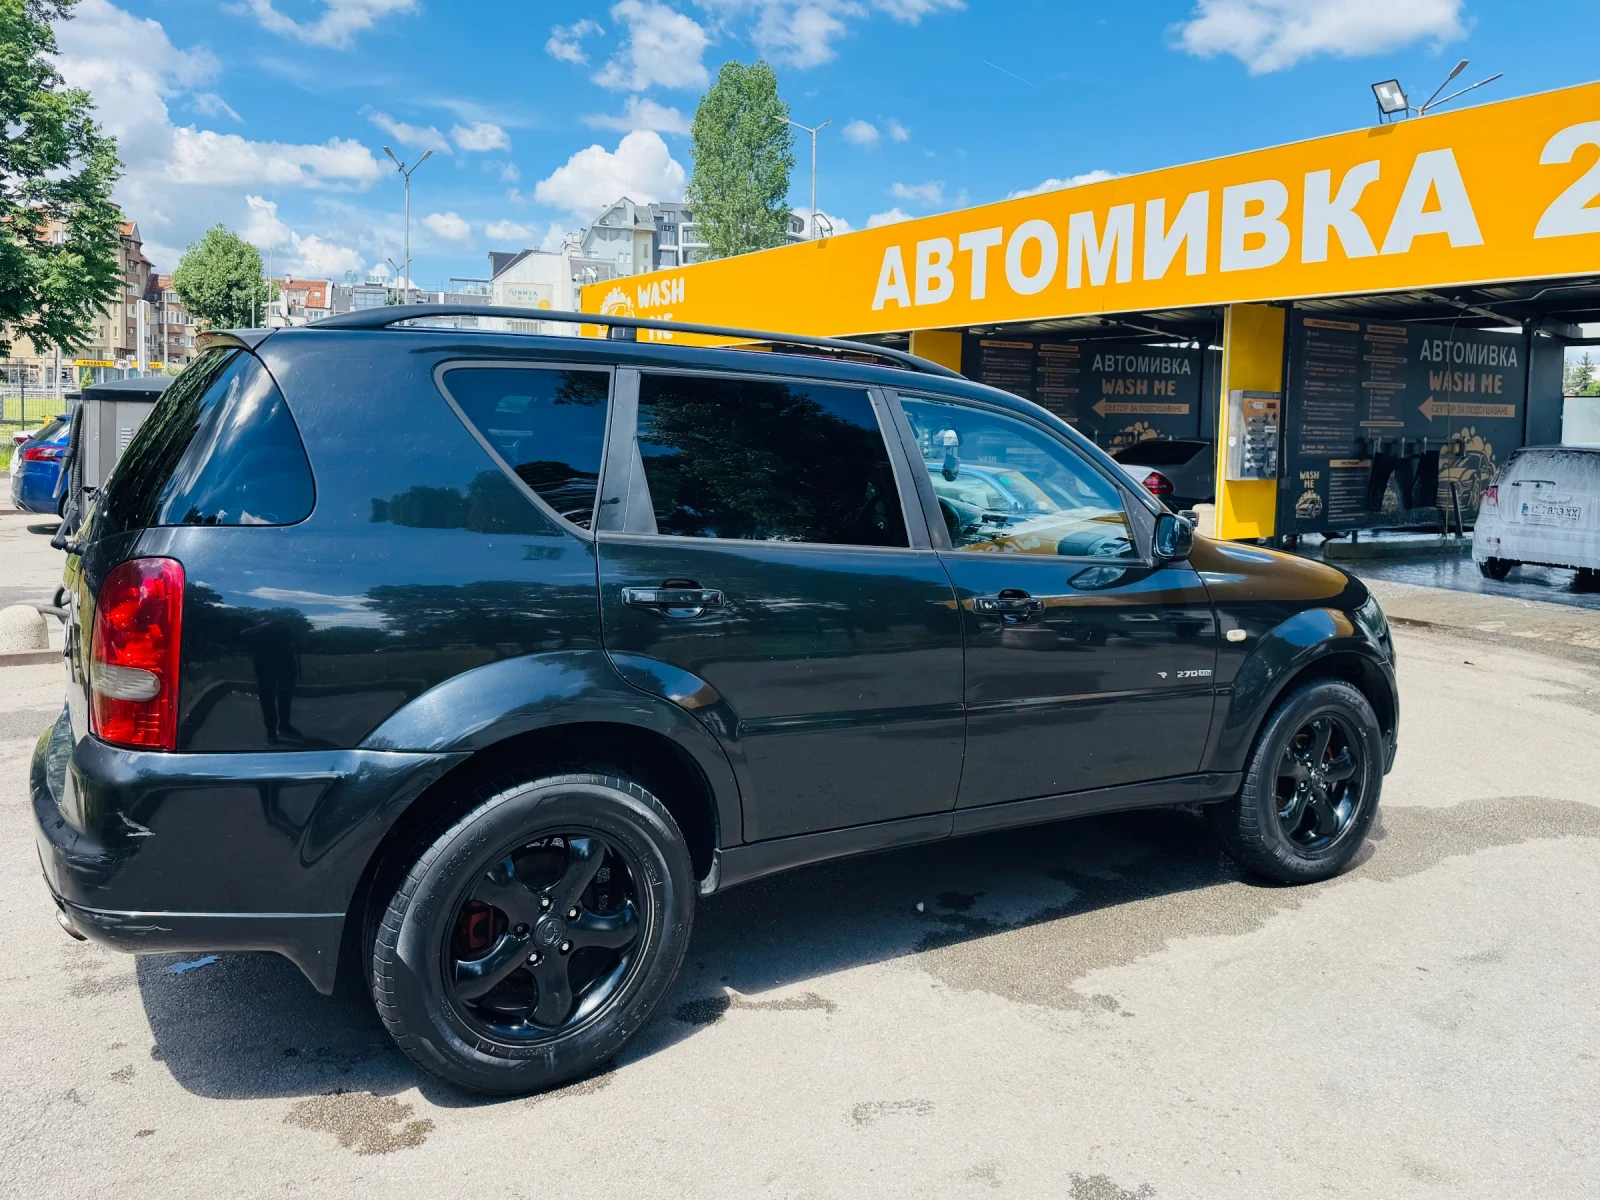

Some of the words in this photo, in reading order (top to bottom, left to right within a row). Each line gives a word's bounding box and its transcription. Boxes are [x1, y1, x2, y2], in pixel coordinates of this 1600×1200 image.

[872, 147, 1485, 312] АВТОМИВКА
[1533, 119, 1600, 239] 2
[637, 276, 685, 309] WASH
[1419, 339, 1518, 368] АВТОМИВКА
[1091, 354, 1191, 375] АВТОМИВКА
[1101, 378, 1148, 395] WASH
[1153, 380, 1176, 396] ME
[1429, 370, 1475, 393] WASH
[1481, 373, 1503, 395] ME
[1104, 404, 1129, 412] СЕКТОР
[1140, 405, 1183, 413] ПОДСУШАВАНЕ
[1431, 404, 1456, 414] СЕКТОР
[1457, 405, 1465, 414] ЗА
[1466, 405, 1509, 416] ПОДСУШАВАНЕ
[1299, 470, 1320, 480] WASH
[1304, 480, 1315, 488] ME
